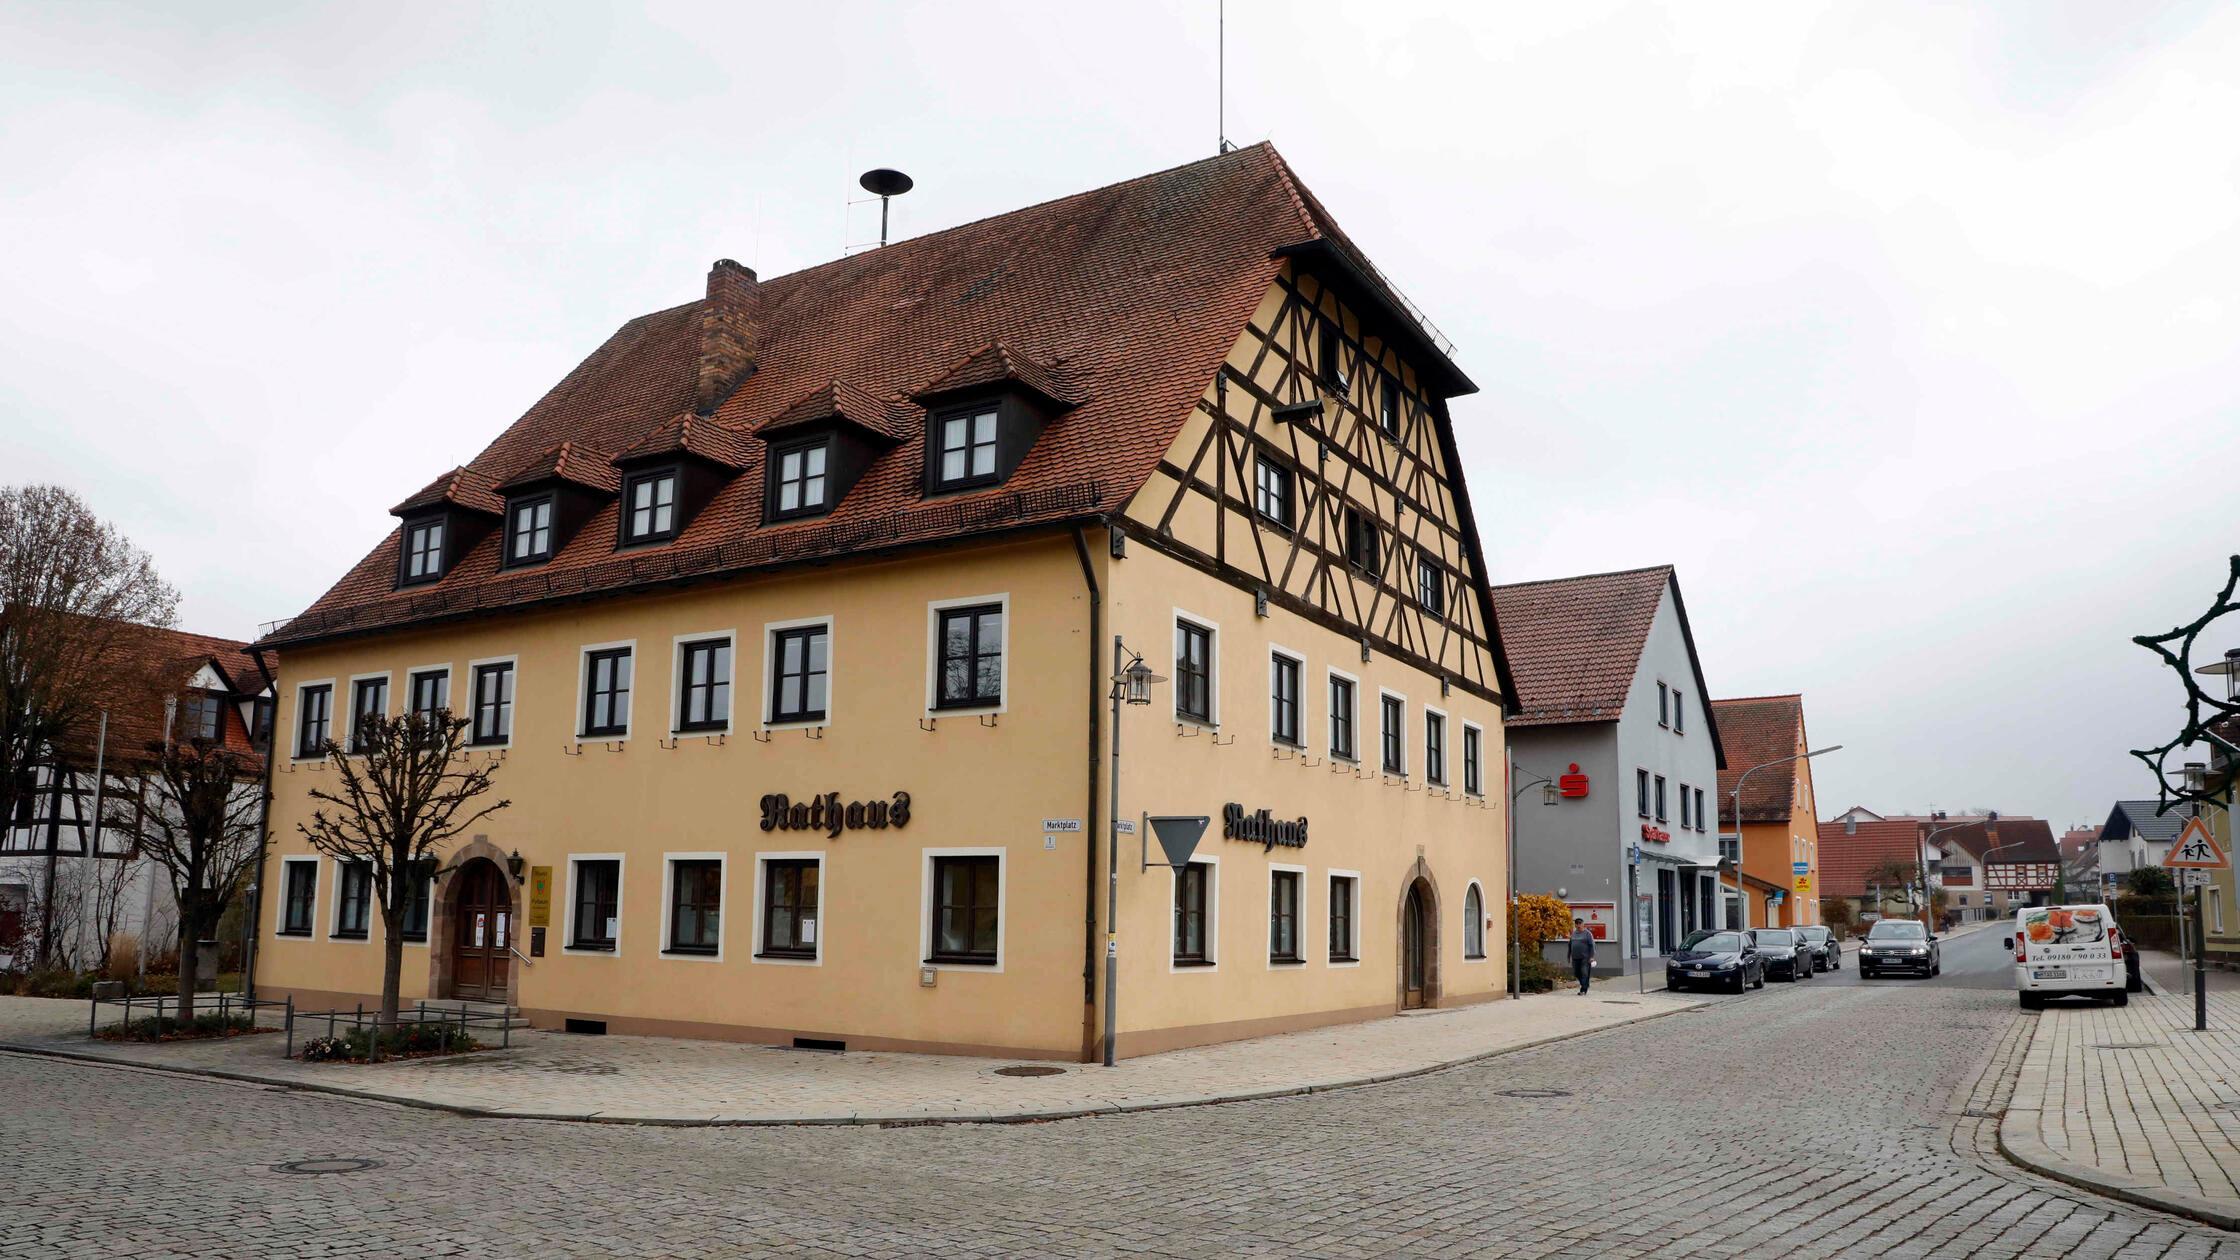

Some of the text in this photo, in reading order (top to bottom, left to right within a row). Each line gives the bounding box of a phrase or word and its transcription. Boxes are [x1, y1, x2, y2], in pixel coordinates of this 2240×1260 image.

[760, 791, 911, 839] Rathaus
[1046, 821, 1077, 831] Marktplatz
[1223, 803, 1308, 854] Rathaus
